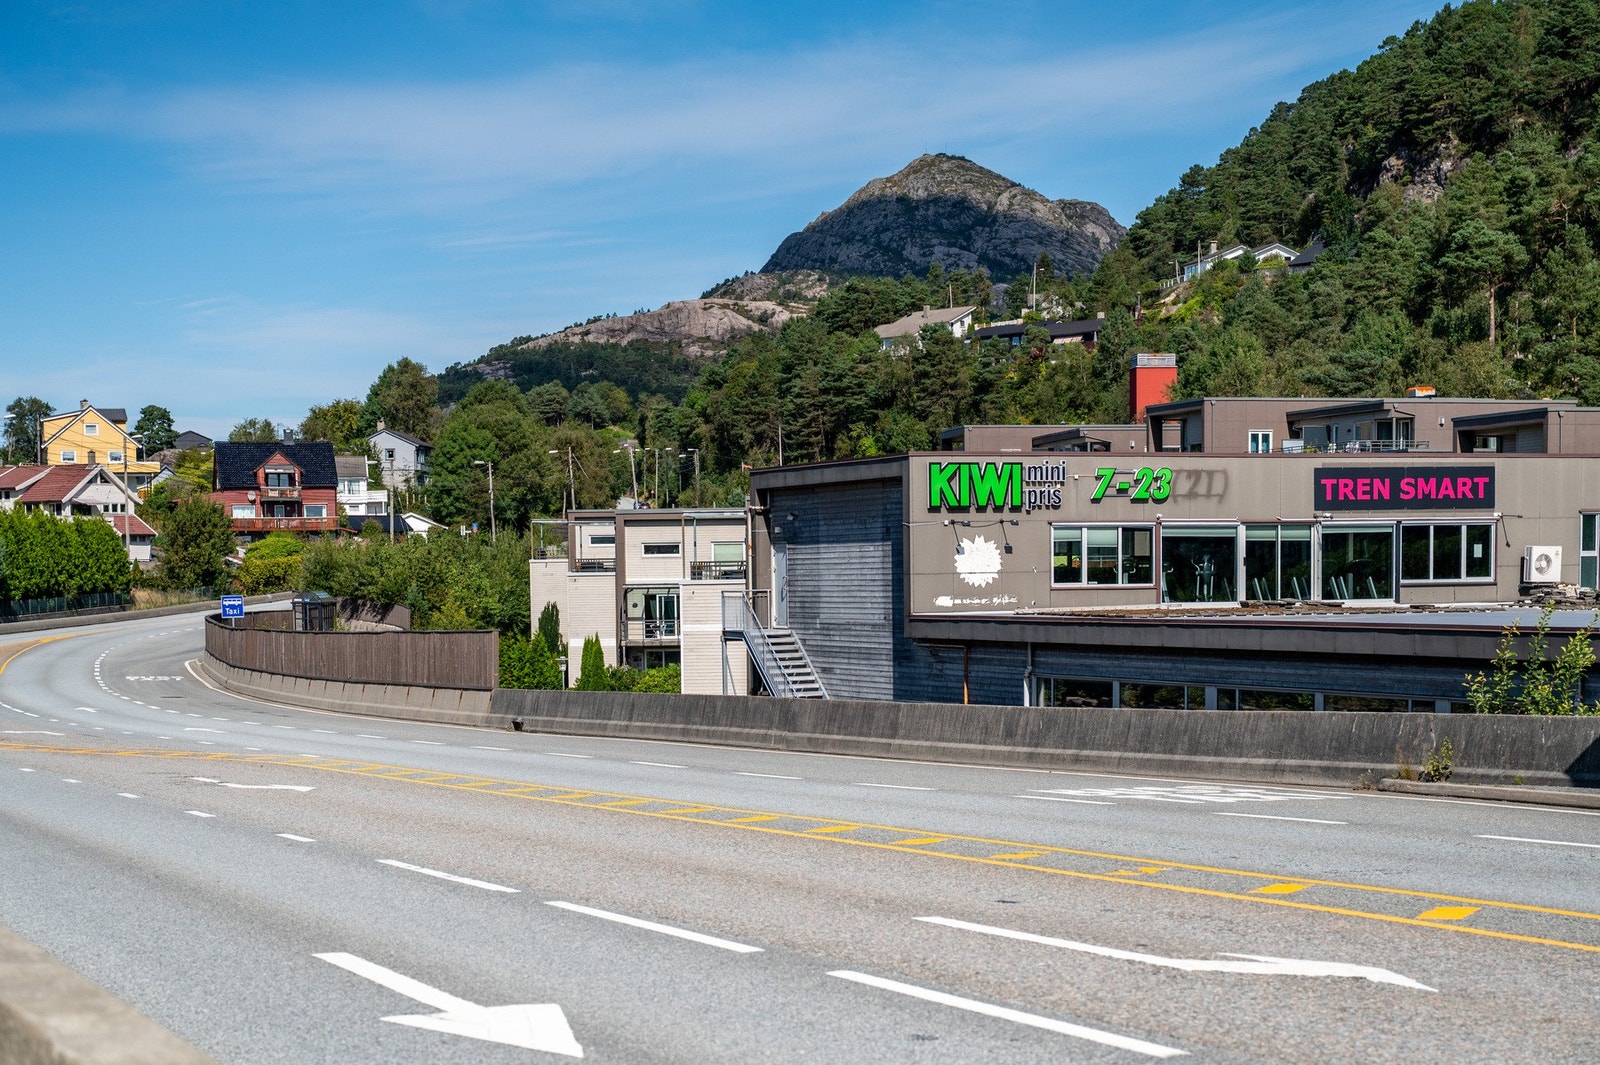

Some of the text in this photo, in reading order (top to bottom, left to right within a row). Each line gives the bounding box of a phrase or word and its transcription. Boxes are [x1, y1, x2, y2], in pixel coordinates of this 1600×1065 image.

[1027, 460, 1066, 482] mini
[928, 462, 1023, 509] KIWI
[1027, 483, 1062, 510] pris
[1091, 467, 1173, 502] 7-23
[1320, 477, 1490, 500] TREN SMART
[225, 607, 240, 615] Taxi
